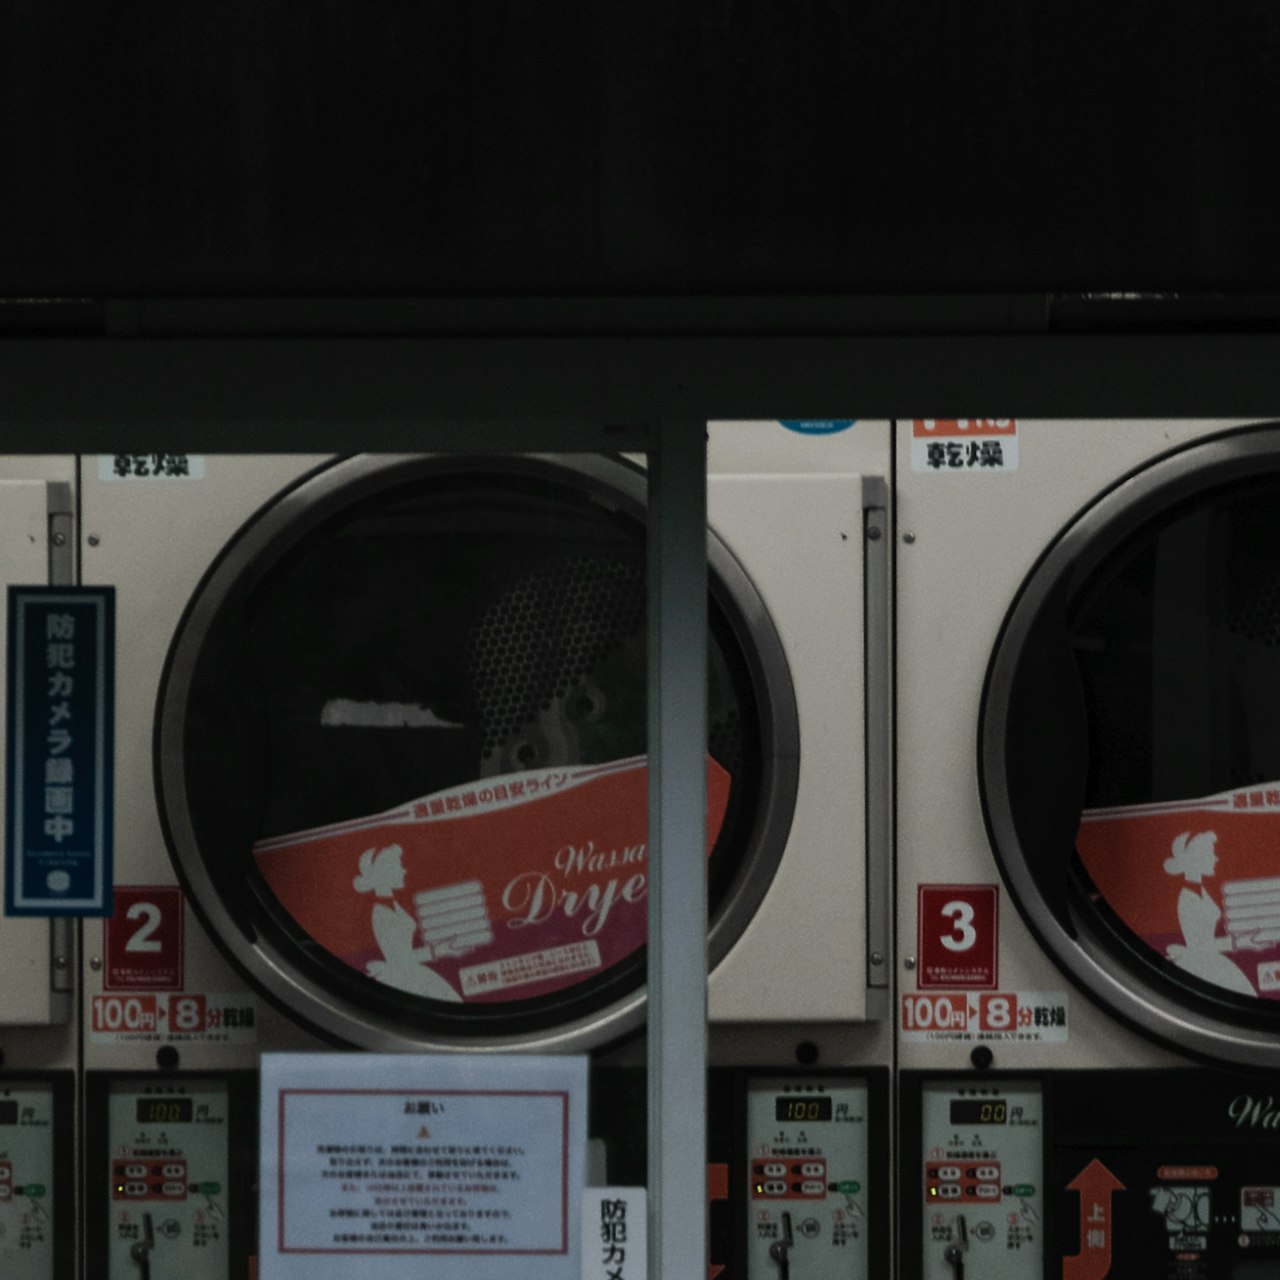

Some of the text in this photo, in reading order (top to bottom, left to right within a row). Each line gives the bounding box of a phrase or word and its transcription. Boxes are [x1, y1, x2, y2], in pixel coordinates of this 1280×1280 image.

[927, 441, 1003, 468] 乾燥
[554, 840, 646, 878] Wassa
[502, 872, 648, 937] Drye
[125, 901, 162, 953] 2
[939, 899, 978, 953] 3
[94, 998, 154, 1029] 100円
[904, 998, 965, 1028] 100円
[788, 1102, 820, 1120] 100
